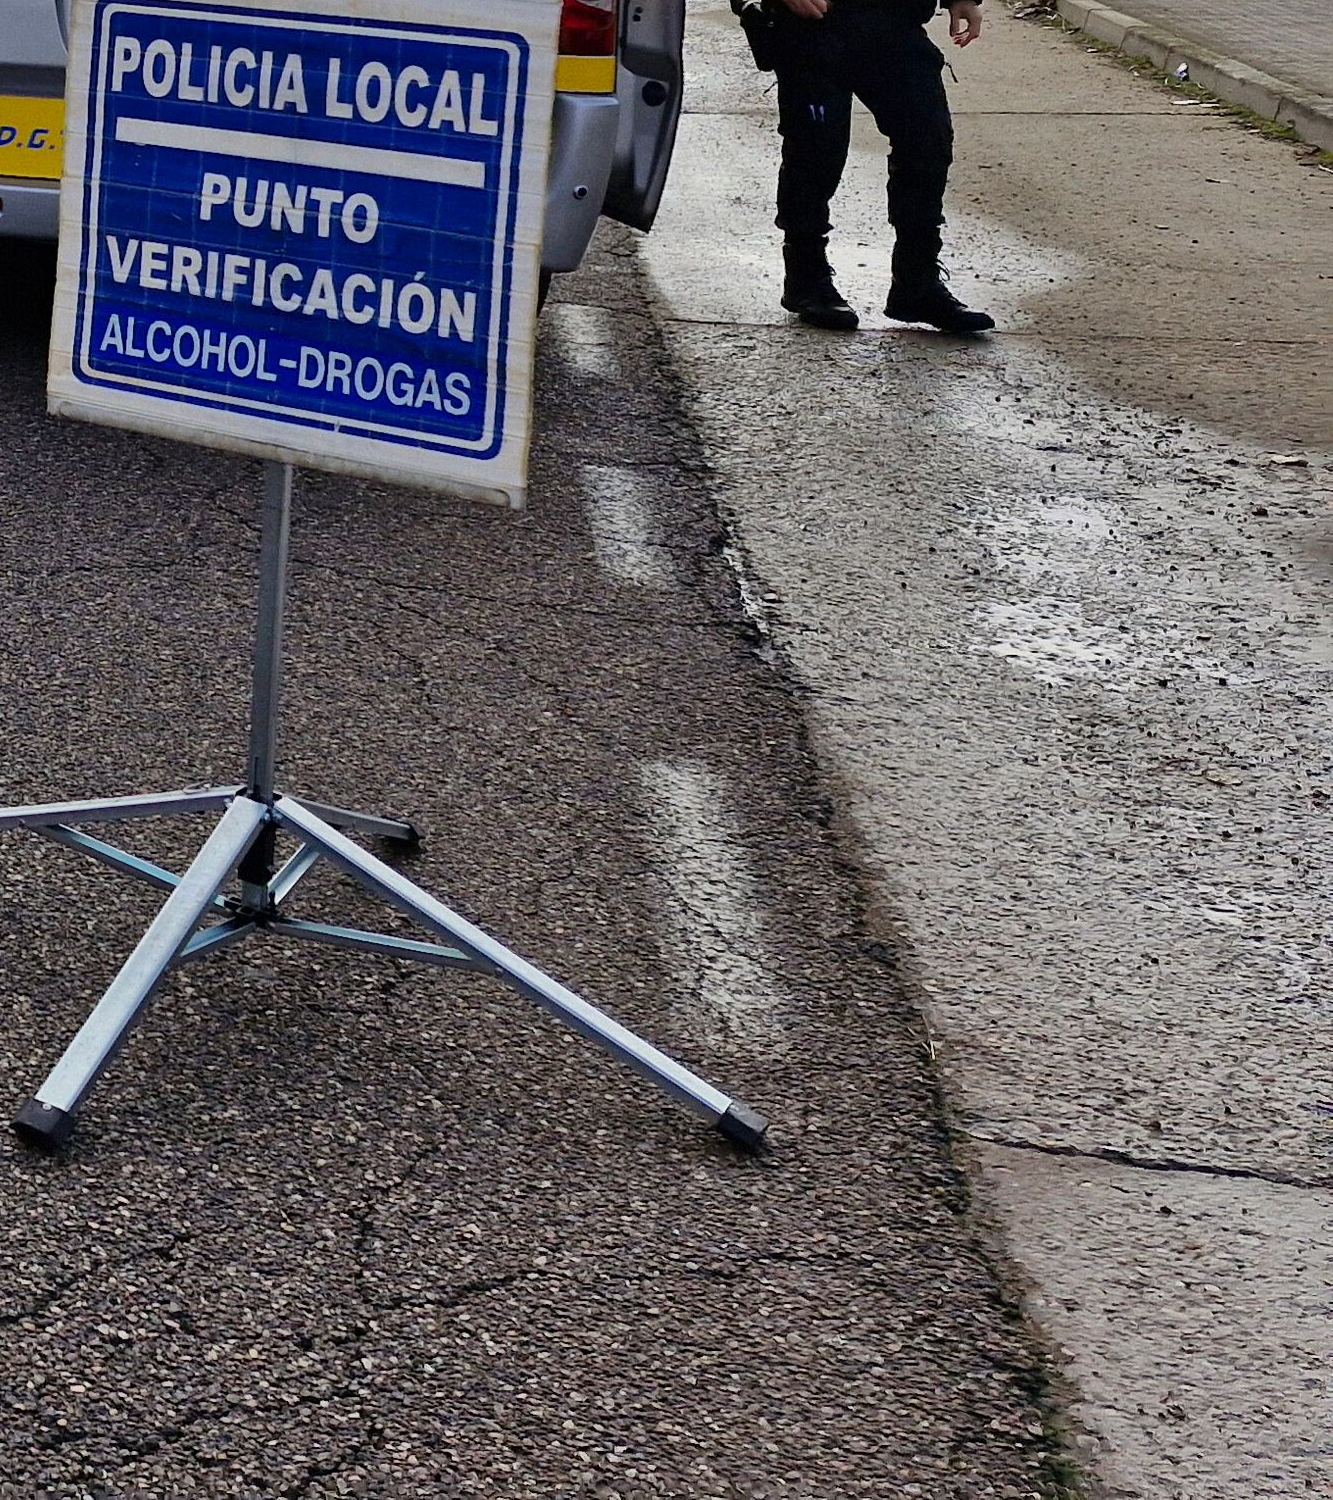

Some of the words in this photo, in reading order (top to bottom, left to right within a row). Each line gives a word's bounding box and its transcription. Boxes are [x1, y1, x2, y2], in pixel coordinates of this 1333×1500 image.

[111, 35, 307, 113] POLICIA
[325, 57, 499, 137] LOCAL
[198, 173, 379, 244] PUNTO
[105, 235, 476, 342] VERIFICACIÓN
[100, 314, 471, 416] ALCOHOL-DROGAS
